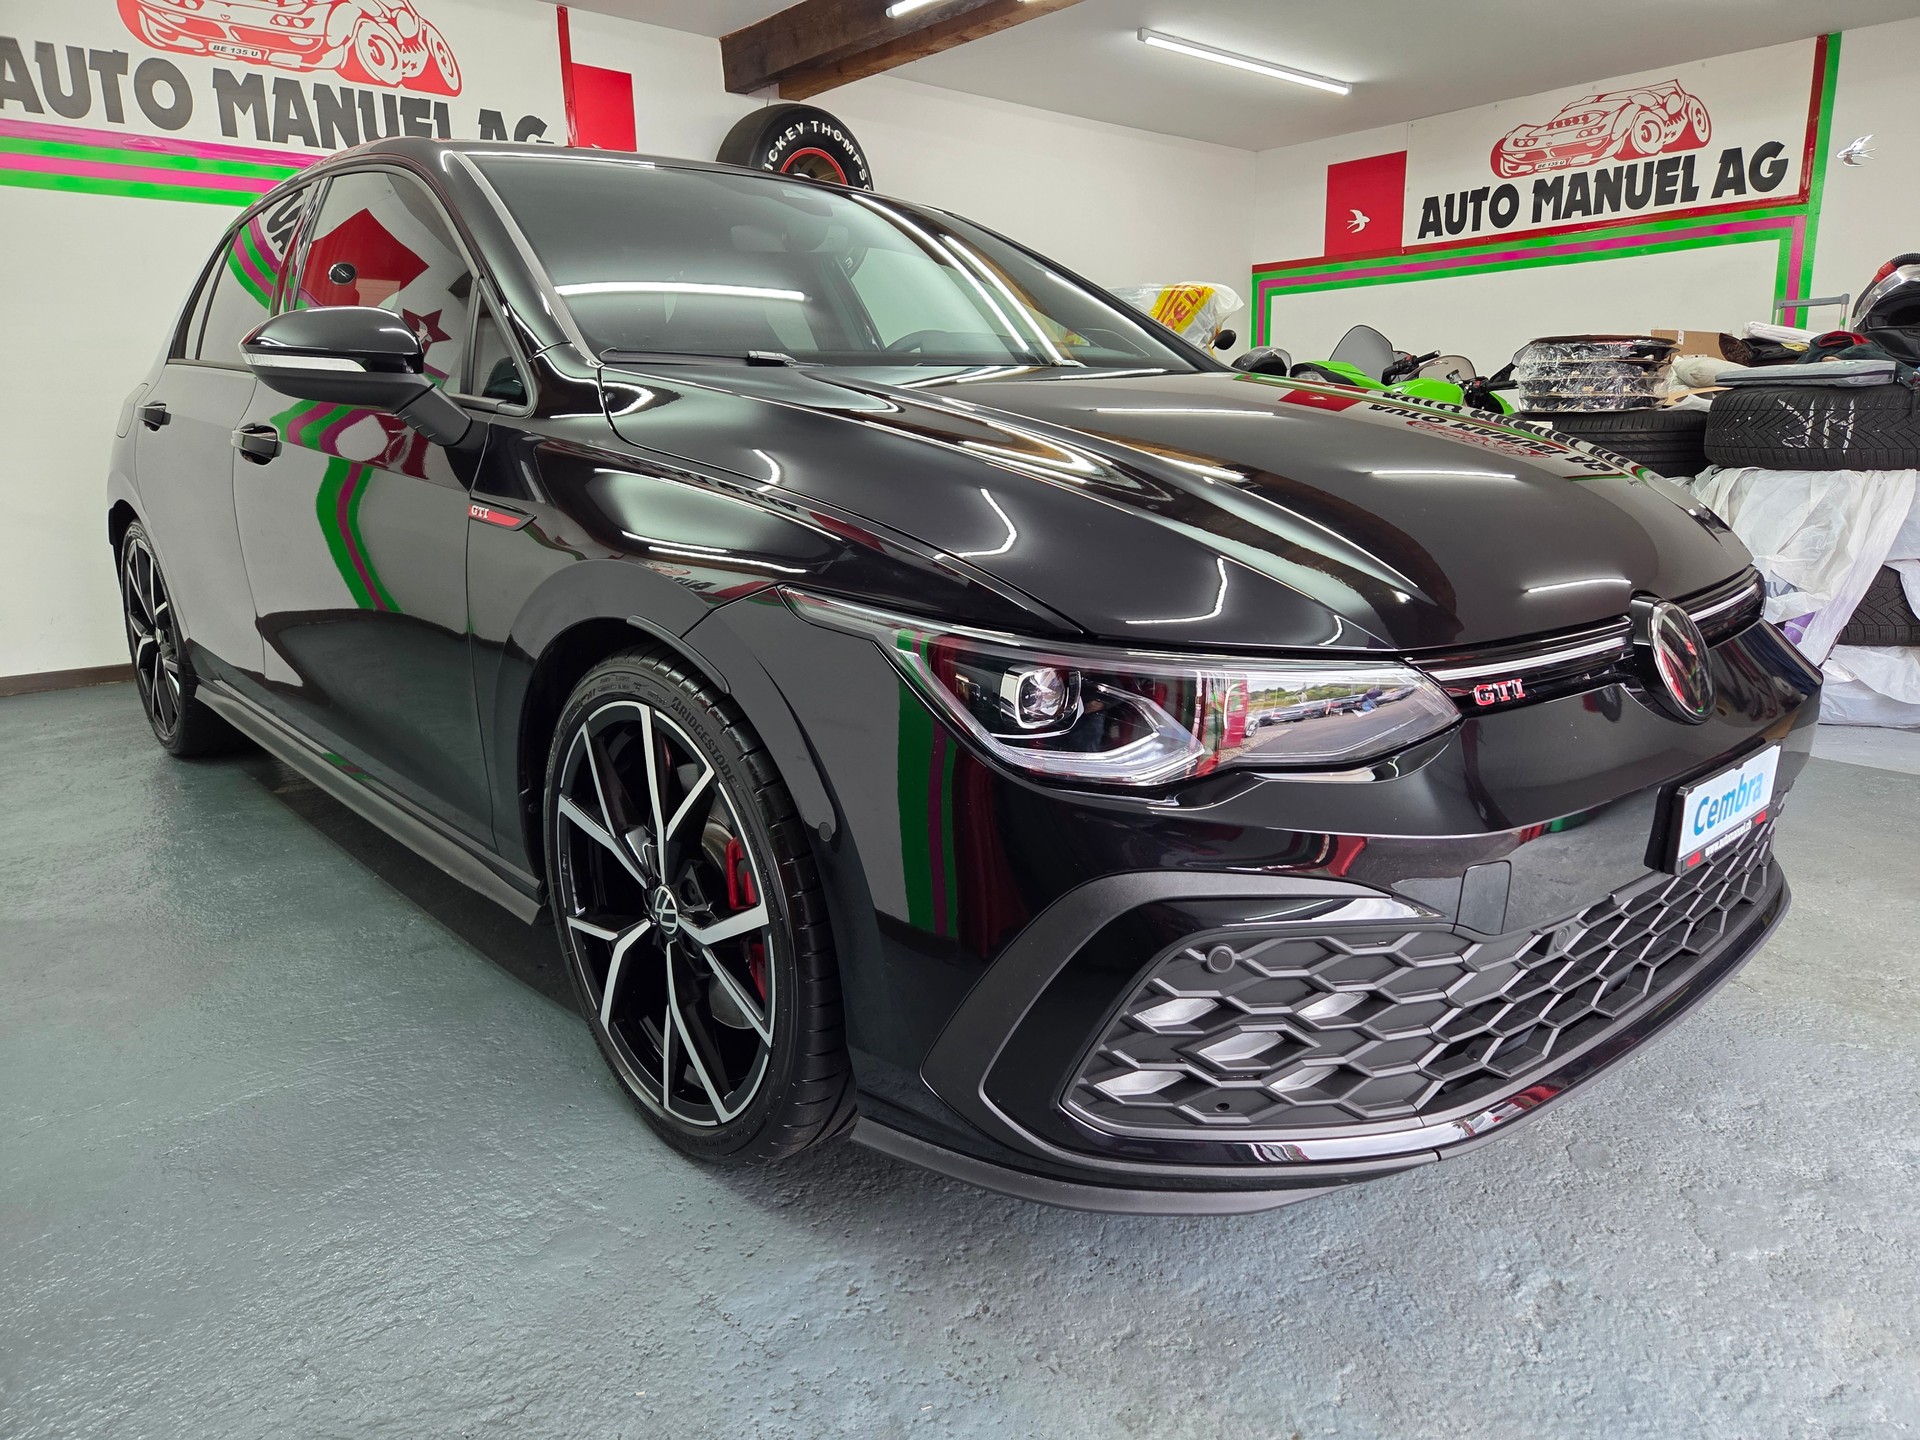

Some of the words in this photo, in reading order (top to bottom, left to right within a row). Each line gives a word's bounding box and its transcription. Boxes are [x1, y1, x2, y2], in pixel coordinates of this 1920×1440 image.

[0, 36, 194, 131] AUTO
[762, 122, 804, 171] ICKEY
[1417, 183, 1520, 239] AUTO
[1531, 154, 1700, 224] MANUEL
[1711, 141, 1789, 199] AG
[471, 505, 489, 519] GTI
[1473, 678, 1526, 706] GTI
[671, 696, 738, 785] BRIDGESTONE
[1693, 772, 1764, 836] Cembra
